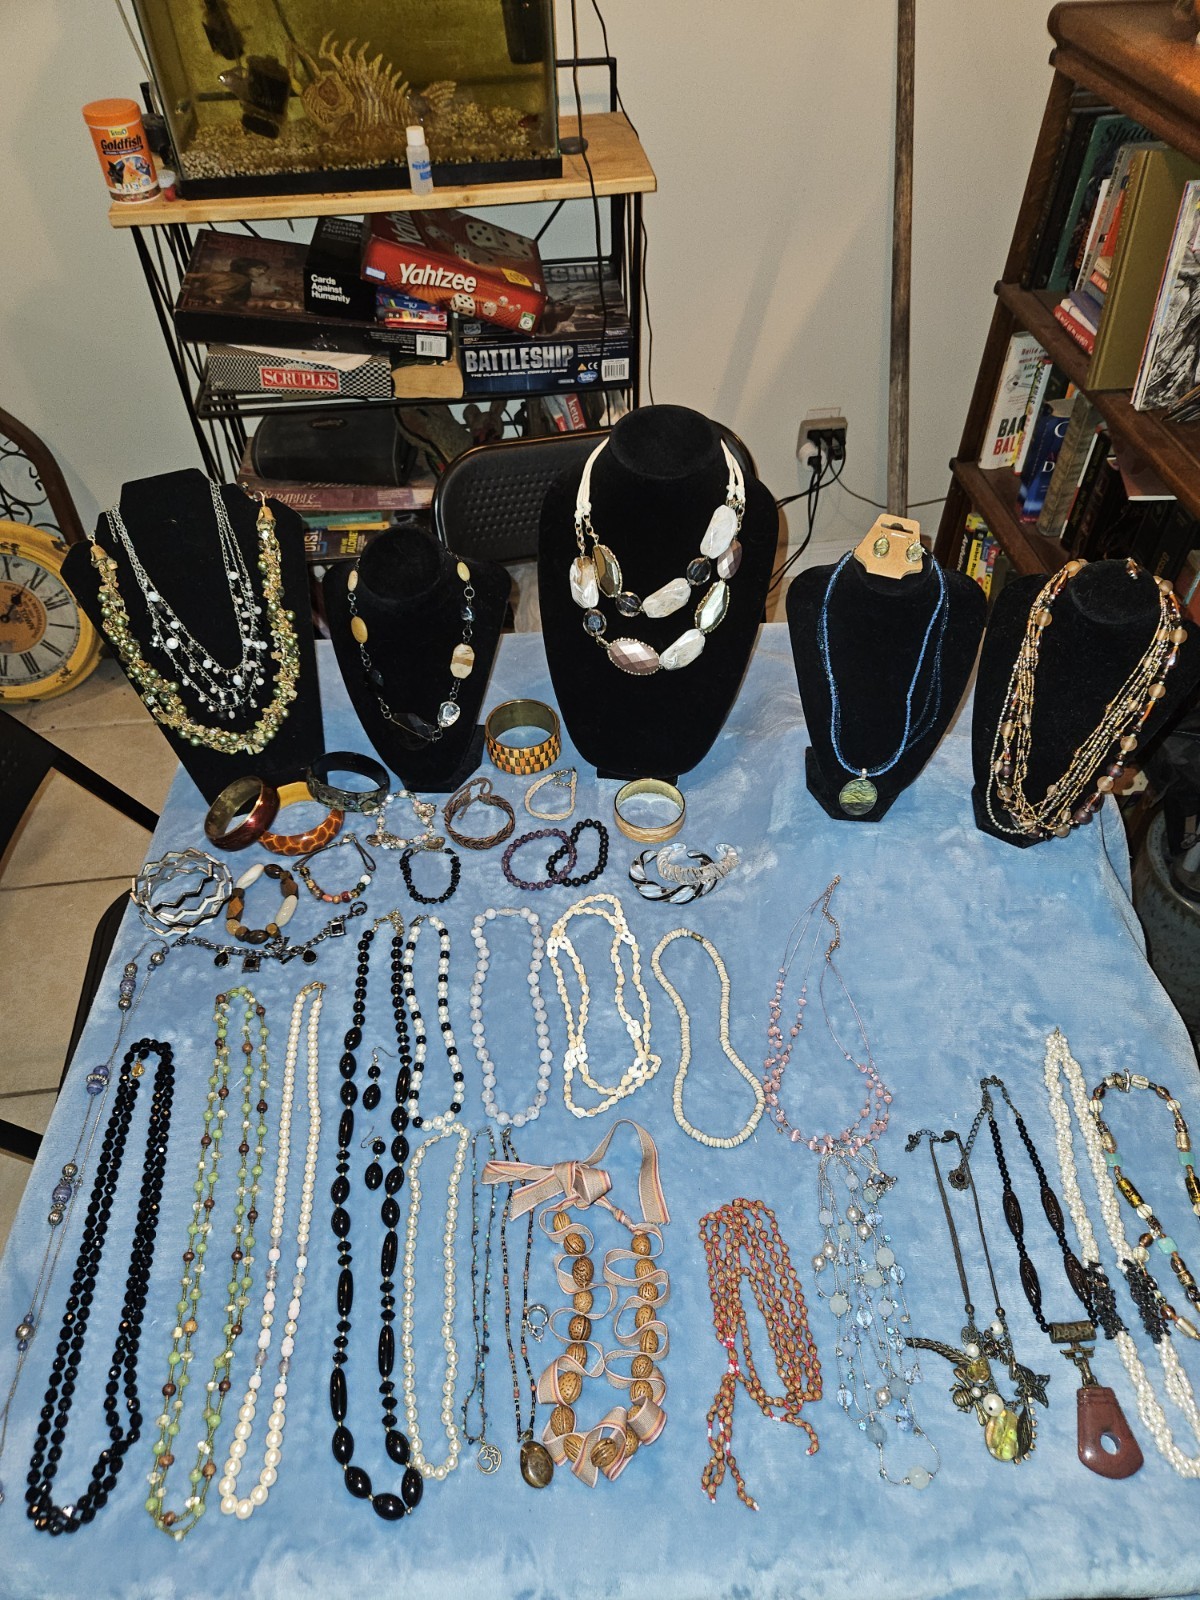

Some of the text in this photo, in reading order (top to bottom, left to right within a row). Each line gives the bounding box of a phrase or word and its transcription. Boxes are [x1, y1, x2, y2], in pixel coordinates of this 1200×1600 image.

[100, 134, 142, 150] Goldfish
[310, 273, 337, 286] Cards
[399, 263, 477, 293] Yahtzee
[311, 282, 343, 295] Against
[311, 290, 351, 304] Humanity
[464, 345, 574, 373] BATTLESHIP
[263, 370, 338, 389] SCRUPLES
[567, 398, 581, 427] keto
